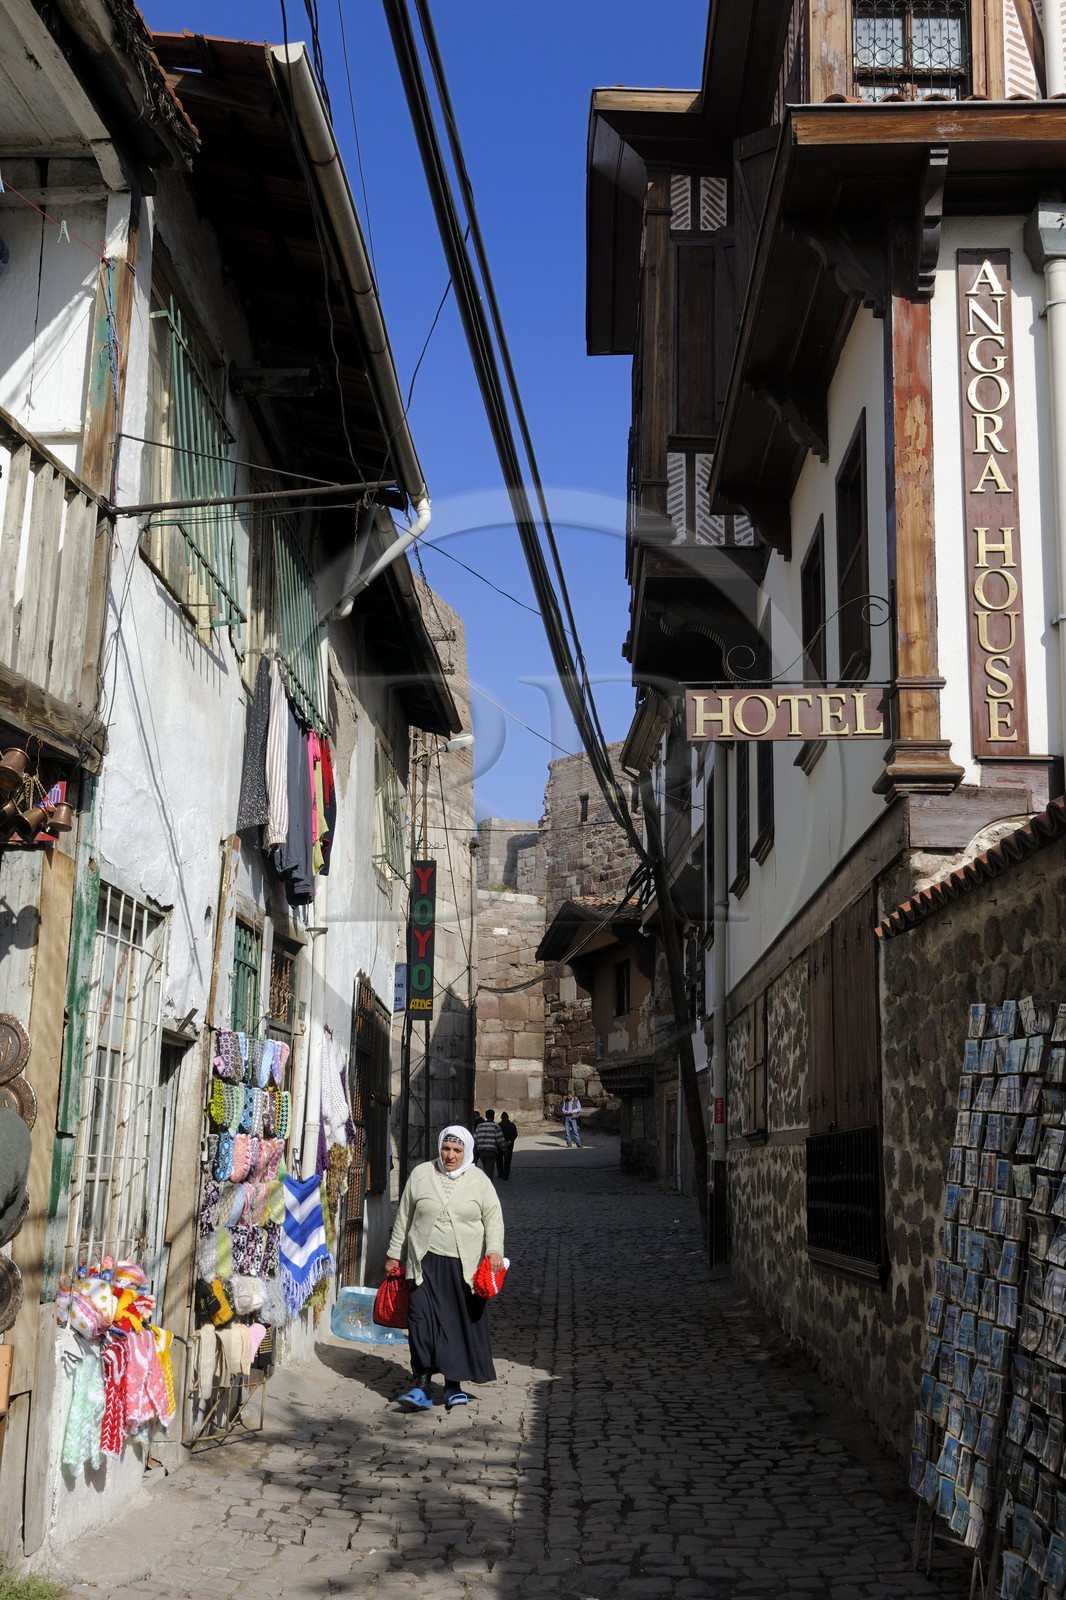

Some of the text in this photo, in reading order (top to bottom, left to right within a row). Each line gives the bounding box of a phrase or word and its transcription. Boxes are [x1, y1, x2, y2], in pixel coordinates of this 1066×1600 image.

[965, 259, 1021, 742] ANGORA HOUSE
[691, 692, 884, 737] HOTEL
[411, 867, 435, 992] YOYO
